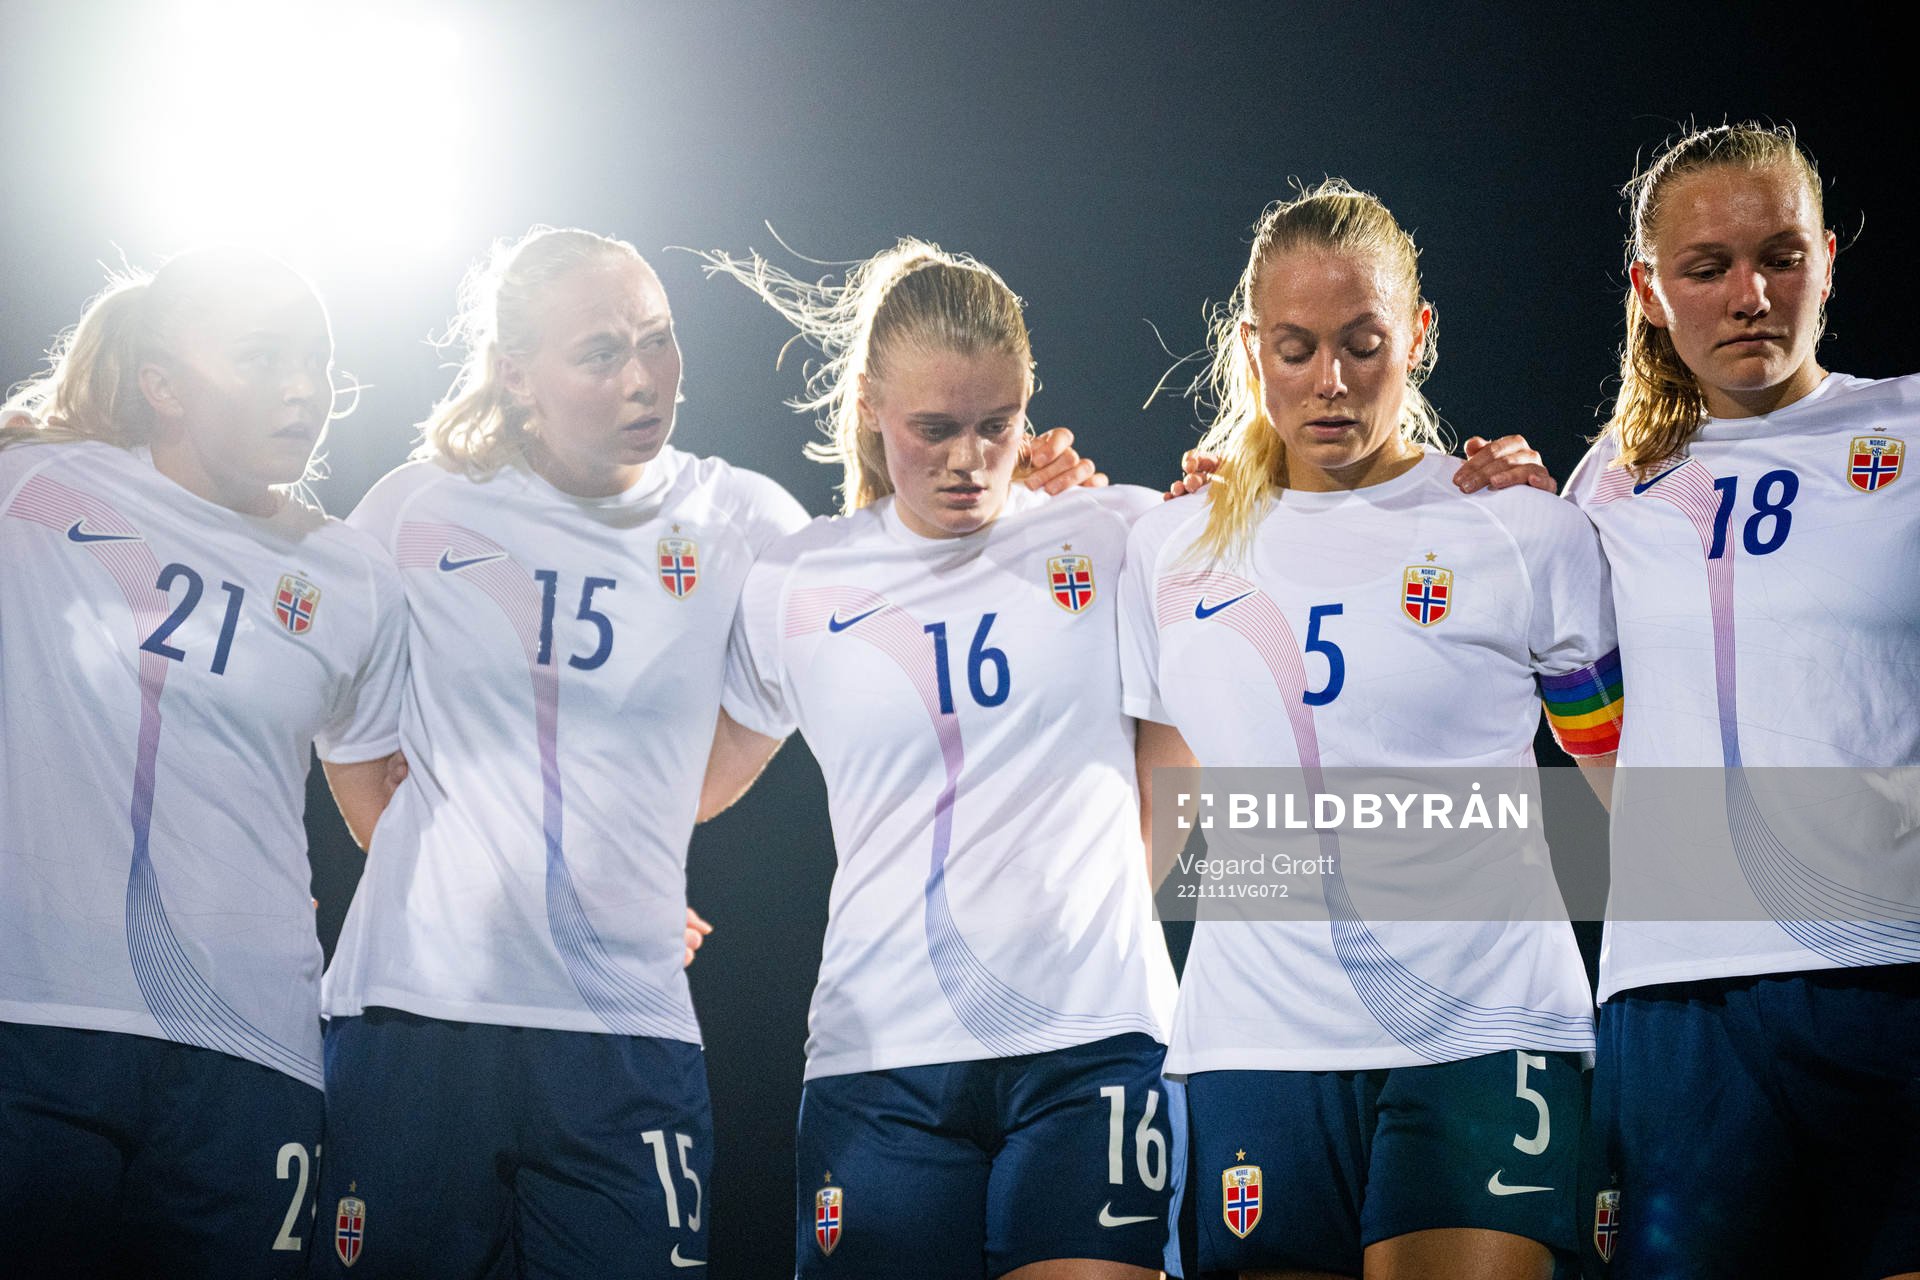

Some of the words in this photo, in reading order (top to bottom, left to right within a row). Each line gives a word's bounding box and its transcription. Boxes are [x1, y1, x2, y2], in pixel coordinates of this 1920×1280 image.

[1708, 469, 1799, 559] 18
[140, 562, 245, 676] 21
[534, 568, 617, 671] 15
[924, 612, 1011, 715] 16
[1303, 602, 1345, 706] 5
[1100, 1085, 1167, 1192] 16
[1513, 1050, 1551, 1156] 5
[272, 1142, 322, 1251] 2
[641, 1129, 703, 1233] 15
